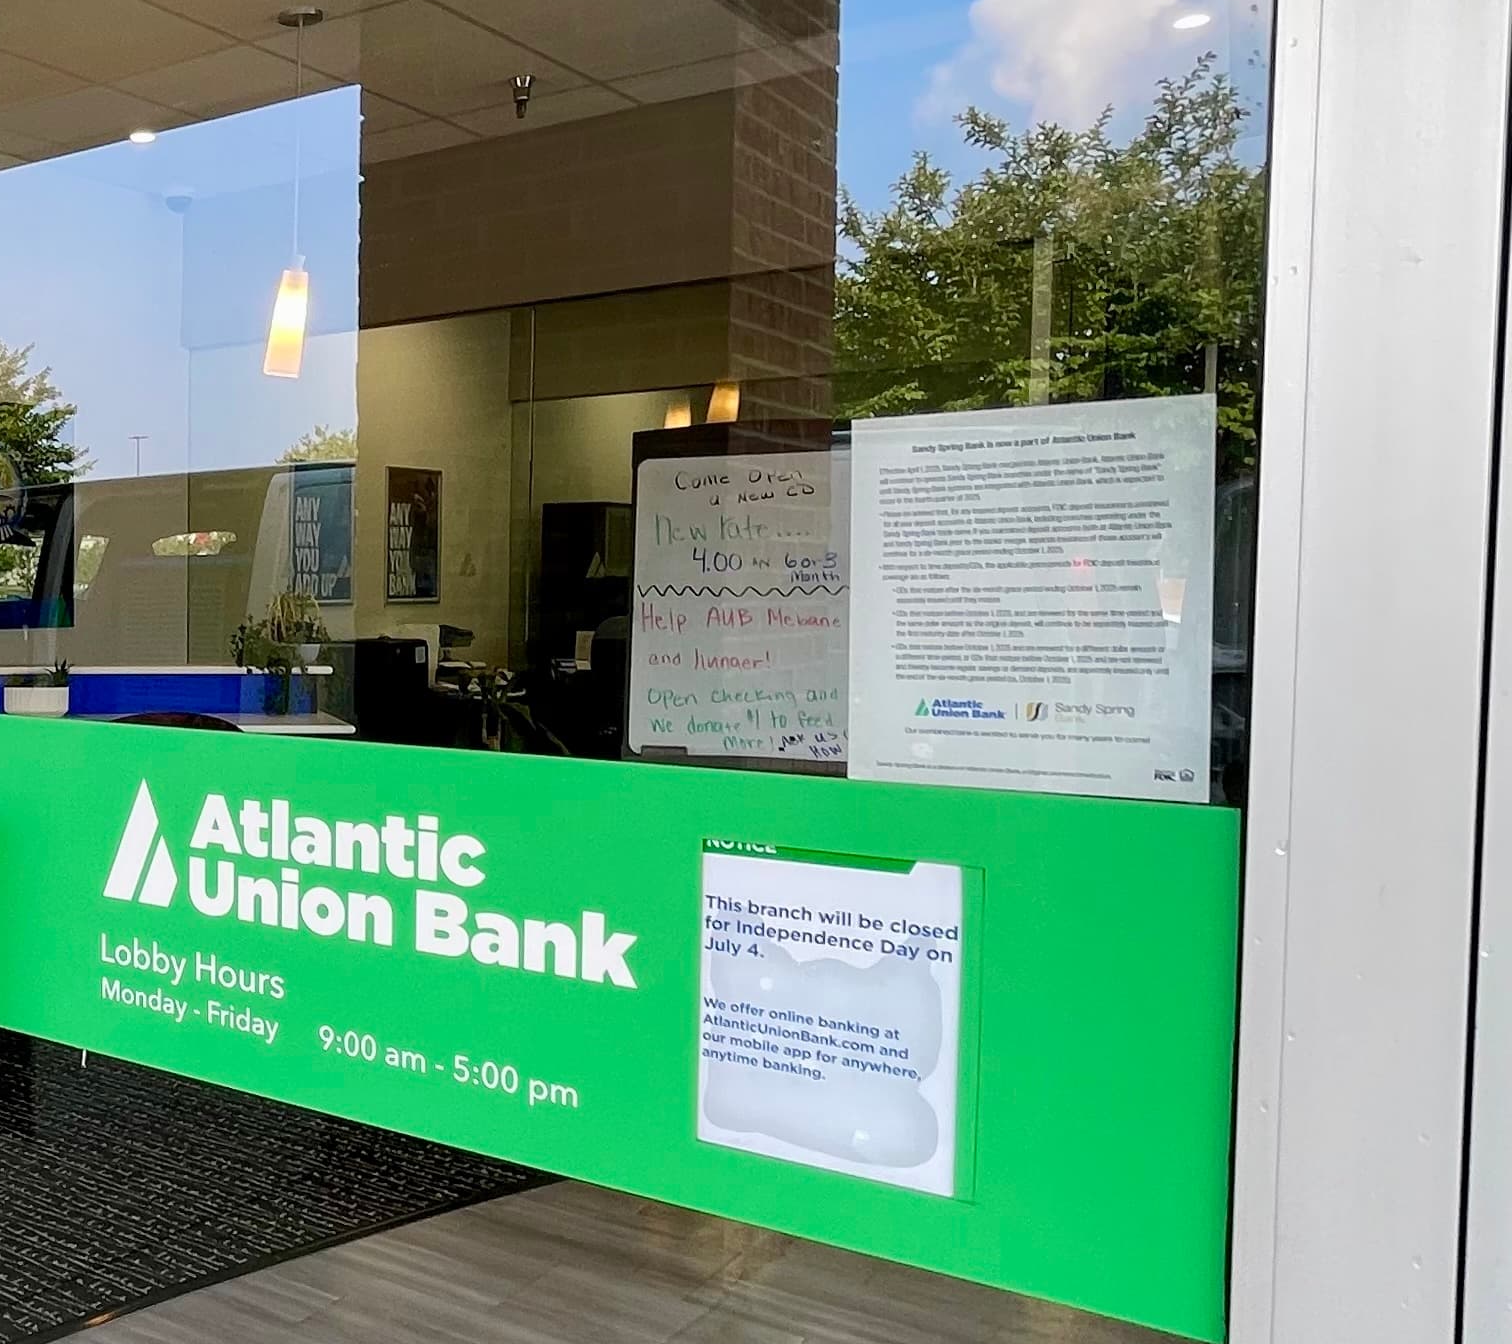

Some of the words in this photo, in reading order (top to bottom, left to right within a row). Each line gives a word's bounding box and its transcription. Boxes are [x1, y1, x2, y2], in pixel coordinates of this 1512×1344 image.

[295, 497, 321, 521] ANY
[390, 502, 411, 525] ANY
[295, 523, 321, 547] WAY
[390, 526, 413, 549] WAY
[295, 548, 320, 572] YOU
[692, 547, 743, 574] 4.00
[641, 602, 688, 633] Help
[931, 709, 969, 718] Union
[972, 709, 1006, 719] Bank
[932, 699, 984, 709] Atlantic
[1055, 701, 1092, 715] Sandy
[1095, 703, 1135, 718] Spring
[189, 793, 487, 888] Atlantic
[187, 854, 393, 947] Union
[414, 888, 639, 990] Bank
[704, 894, 742, 913] This
[747, 899, 813, 923] branch
[818, 910, 852, 927] will
[858, 913, 884, 931] be
[890, 919, 959, 941] closed
[704, 915, 732, 933] for
[736, 919, 874, 953] Independence
[880, 939, 920, 962] Day
[926, 946, 954, 963] on
[704, 936, 741, 956] July
[746, 943, 765, 958] 4.
[99, 932, 187, 983] Lobby
[195, 951, 286, 1000] Hours
[703, 997, 727, 1011] We
[730, 1000, 765, 1018] offer
[768, 1008, 814, 1026] online
[818, 1015, 880, 1039] banking
[884, 1028, 900, 1041] at
[101, 976, 188, 1022] Monday
[207, 1001, 279, 1044] Friday
[318, 1025, 377, 1062] 9:00
[385, 1045, 427, 1074] am
[452, 1056, 519, 1094] 5:00
[528, 1076, 579, 1109] pm
[702, 1013, 875, 1055] AtlanticUnionBank.com
[879, 1044, 909, 1060] and
[701, 1047, 758, 1068] anytime
[762, 1057, 826, 1080] banking.
[702, 1031, 726, 1044] our
[730, 1034, 779, 1055] mobile
[783, 1046, 812, 1062] app
[816, 1050, 838, 1065] for
[841, 1056, 922, 1082] anywhere,
